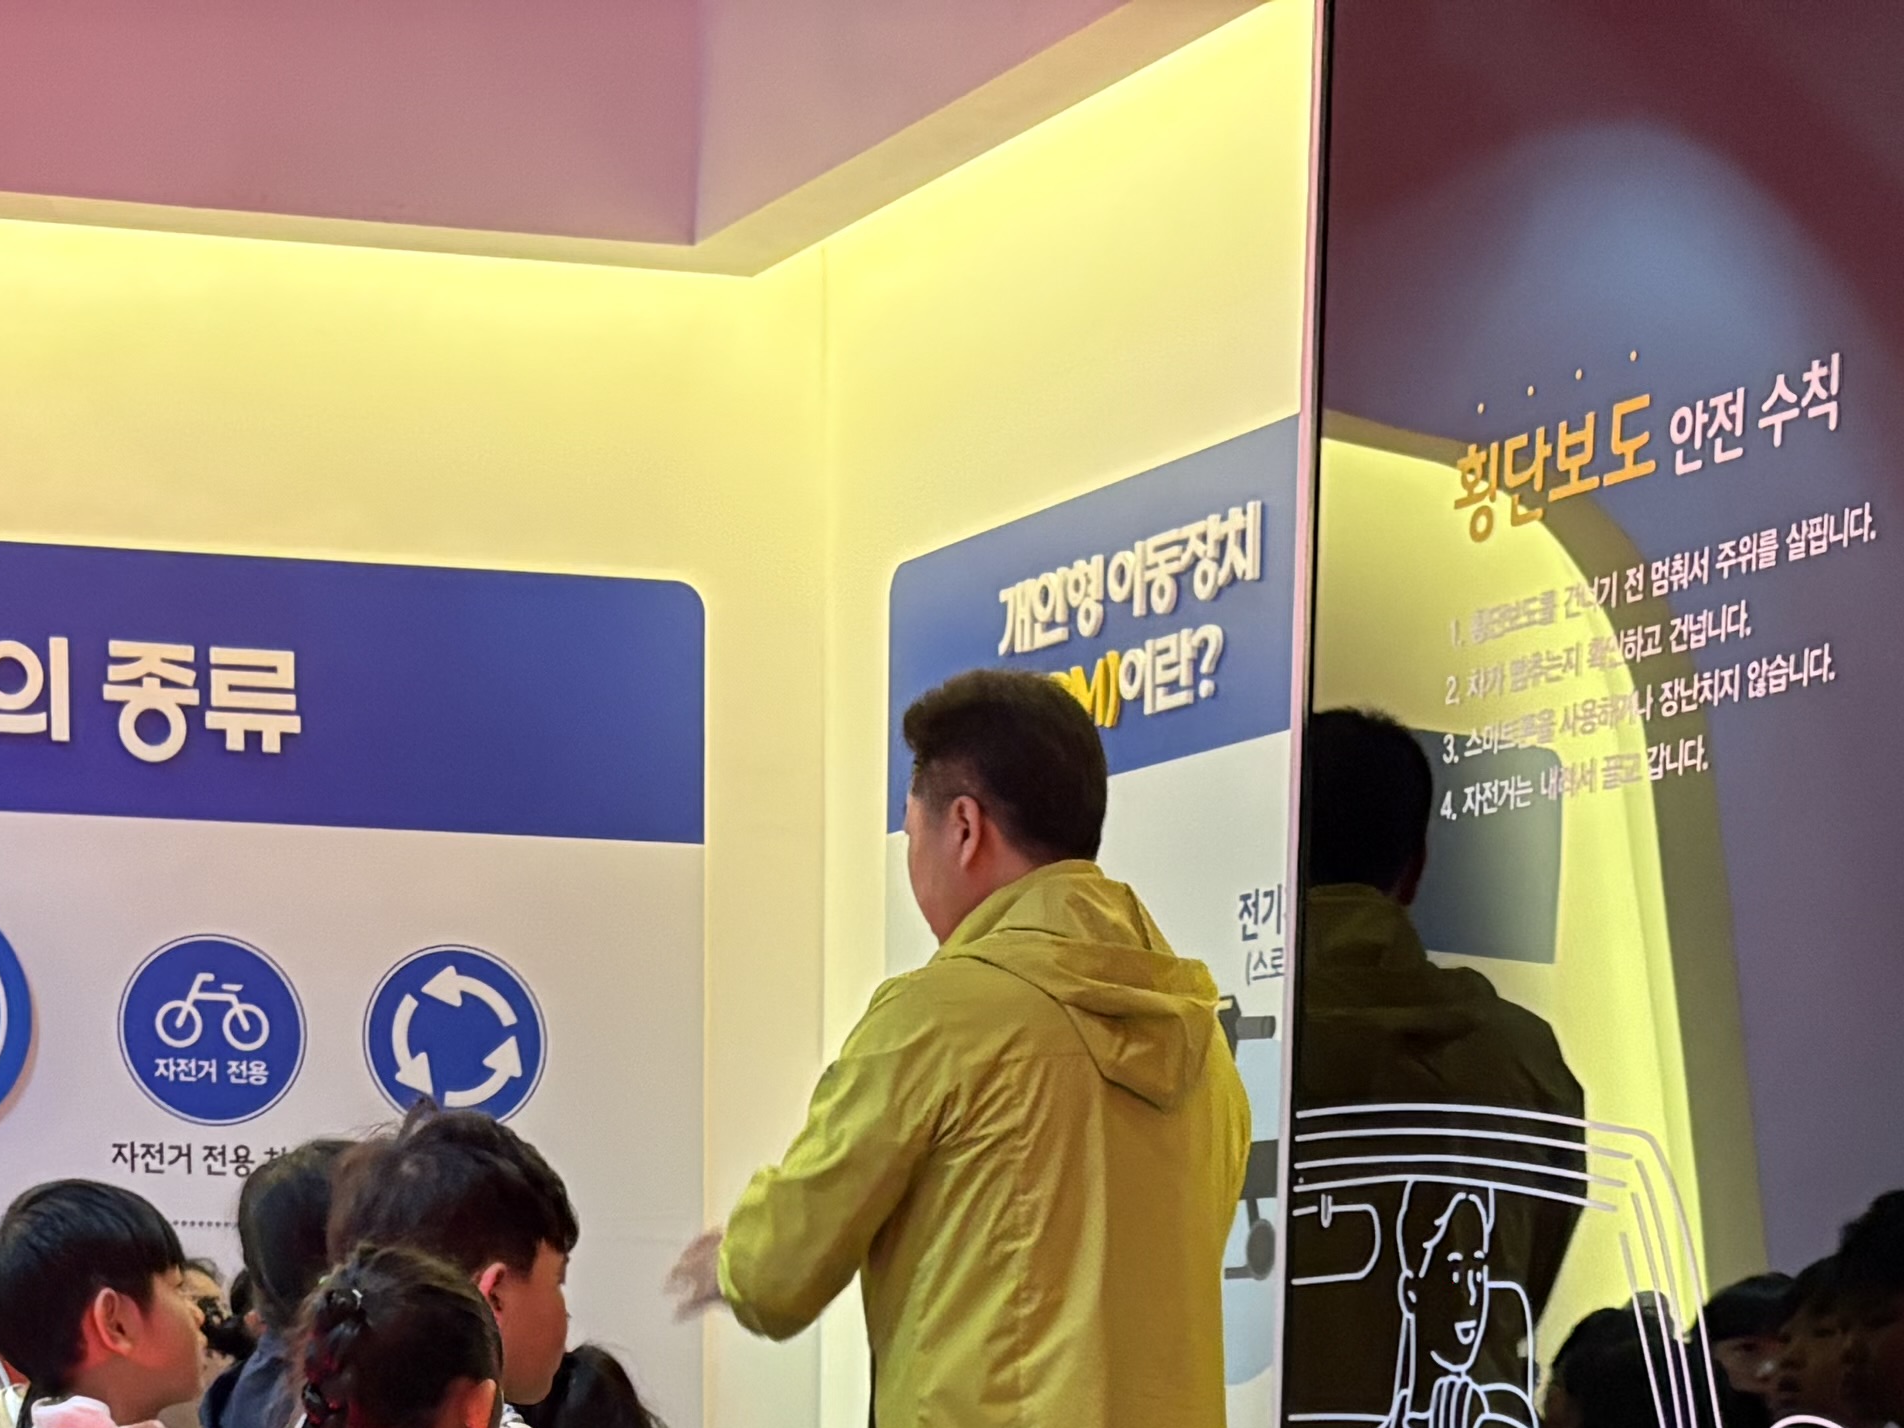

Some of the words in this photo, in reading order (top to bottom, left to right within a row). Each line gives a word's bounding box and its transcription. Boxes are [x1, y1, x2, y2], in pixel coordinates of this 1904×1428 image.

[1454, 393, 1657, 543] 횡단보도
[1668, 384, 1747, 477] 안전
[1757, 351, 1843, 449] 수칙
[998, 554, 1105, 657] 개인형
[1107, 500, 1263, 618] 이동장치
[1624, 564, 1644, 604] 전
[1651, 545, 1710, 596] 멈춰서
[1716, 527, 1779, 580] 주위를
[1786, 502, 1876, 563] 살핍니다.
[1050, 624, 1223, 729] M)이란?
[1466, 662, 1505, 698] 차가
[1669, 599, 1752, 654] 건넙니다.
[101, 638, 305, 764] 종류
[1442, 733, 1460, 764] 3.
[1659, 663, 1741, 719] 장난치지
[1747, 643, 1836, 699] 않습니다.
[1439, 790, 1457, 821] 4.
[1462, 774, 1534, 817] 자전거는
[1647, 734, 1709, 782] 갑니다.
[154, 1057, 217, 1083] 자전거
[226, 1060, 269, 1085] 전용
[111, 1141, 192, 1175] 자전거
[202, 1144, 256, 1178] 전용
